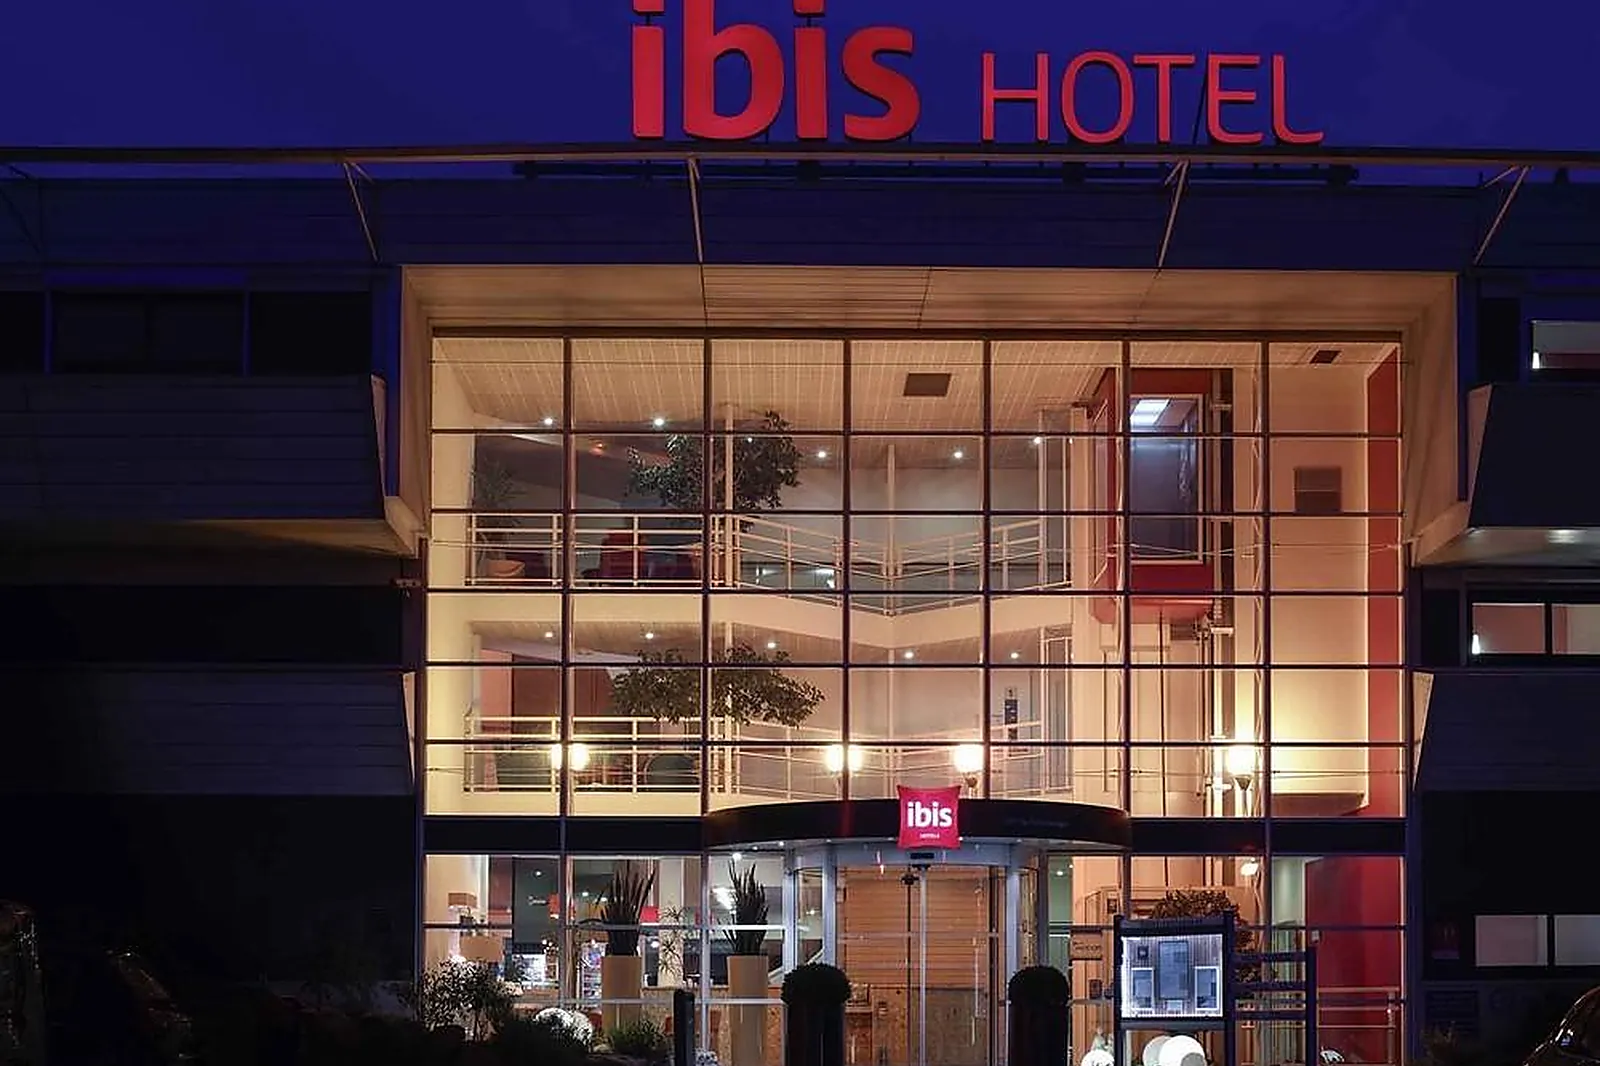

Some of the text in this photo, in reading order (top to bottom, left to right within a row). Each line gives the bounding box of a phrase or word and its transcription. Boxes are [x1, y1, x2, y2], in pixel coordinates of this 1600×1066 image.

[631, 0, 1324, 144] ibis HOTEL
[907, 801, 953, 828] ibis
